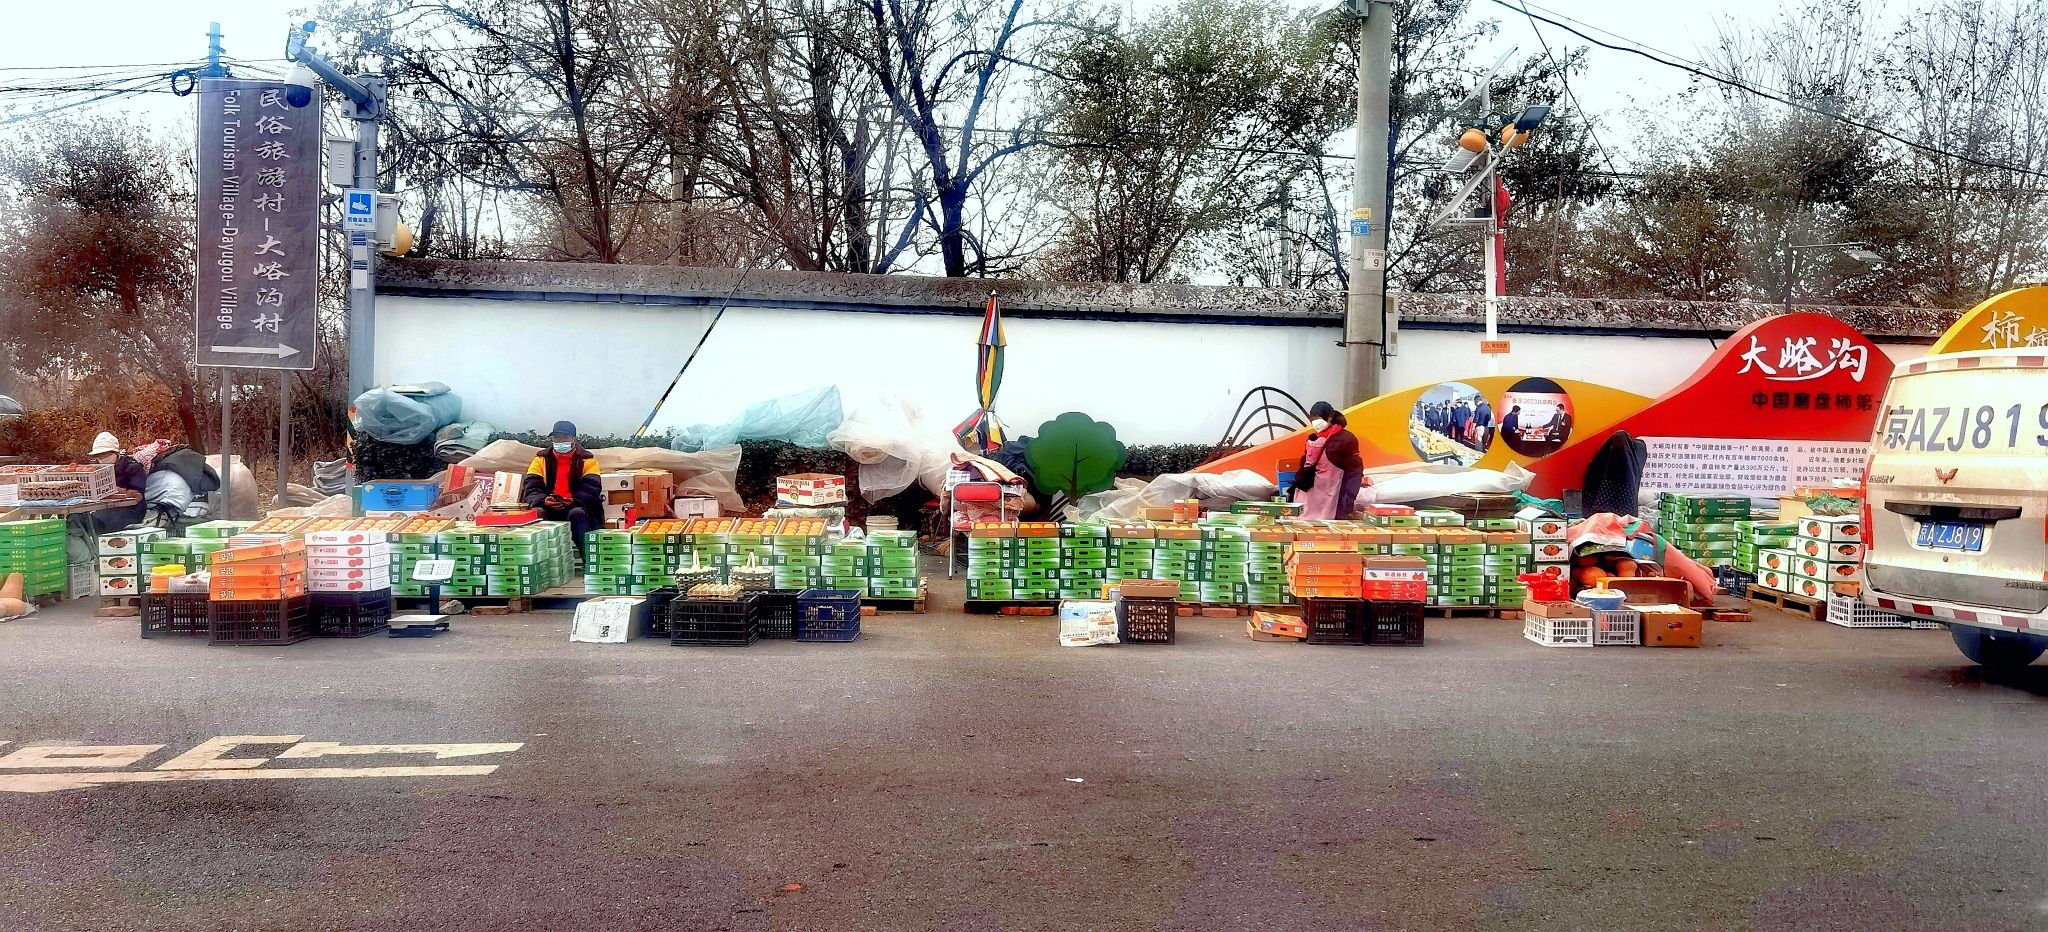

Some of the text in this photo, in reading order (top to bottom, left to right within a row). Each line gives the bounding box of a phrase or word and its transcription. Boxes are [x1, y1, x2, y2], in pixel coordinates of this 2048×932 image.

[217, 90, 240, 330] Folk Tourism Village-Dayugou Village
[1737, 335, 1868, 382] 大峪沟
[1752, 391, 1881, 411] 中国磨盘柿第
